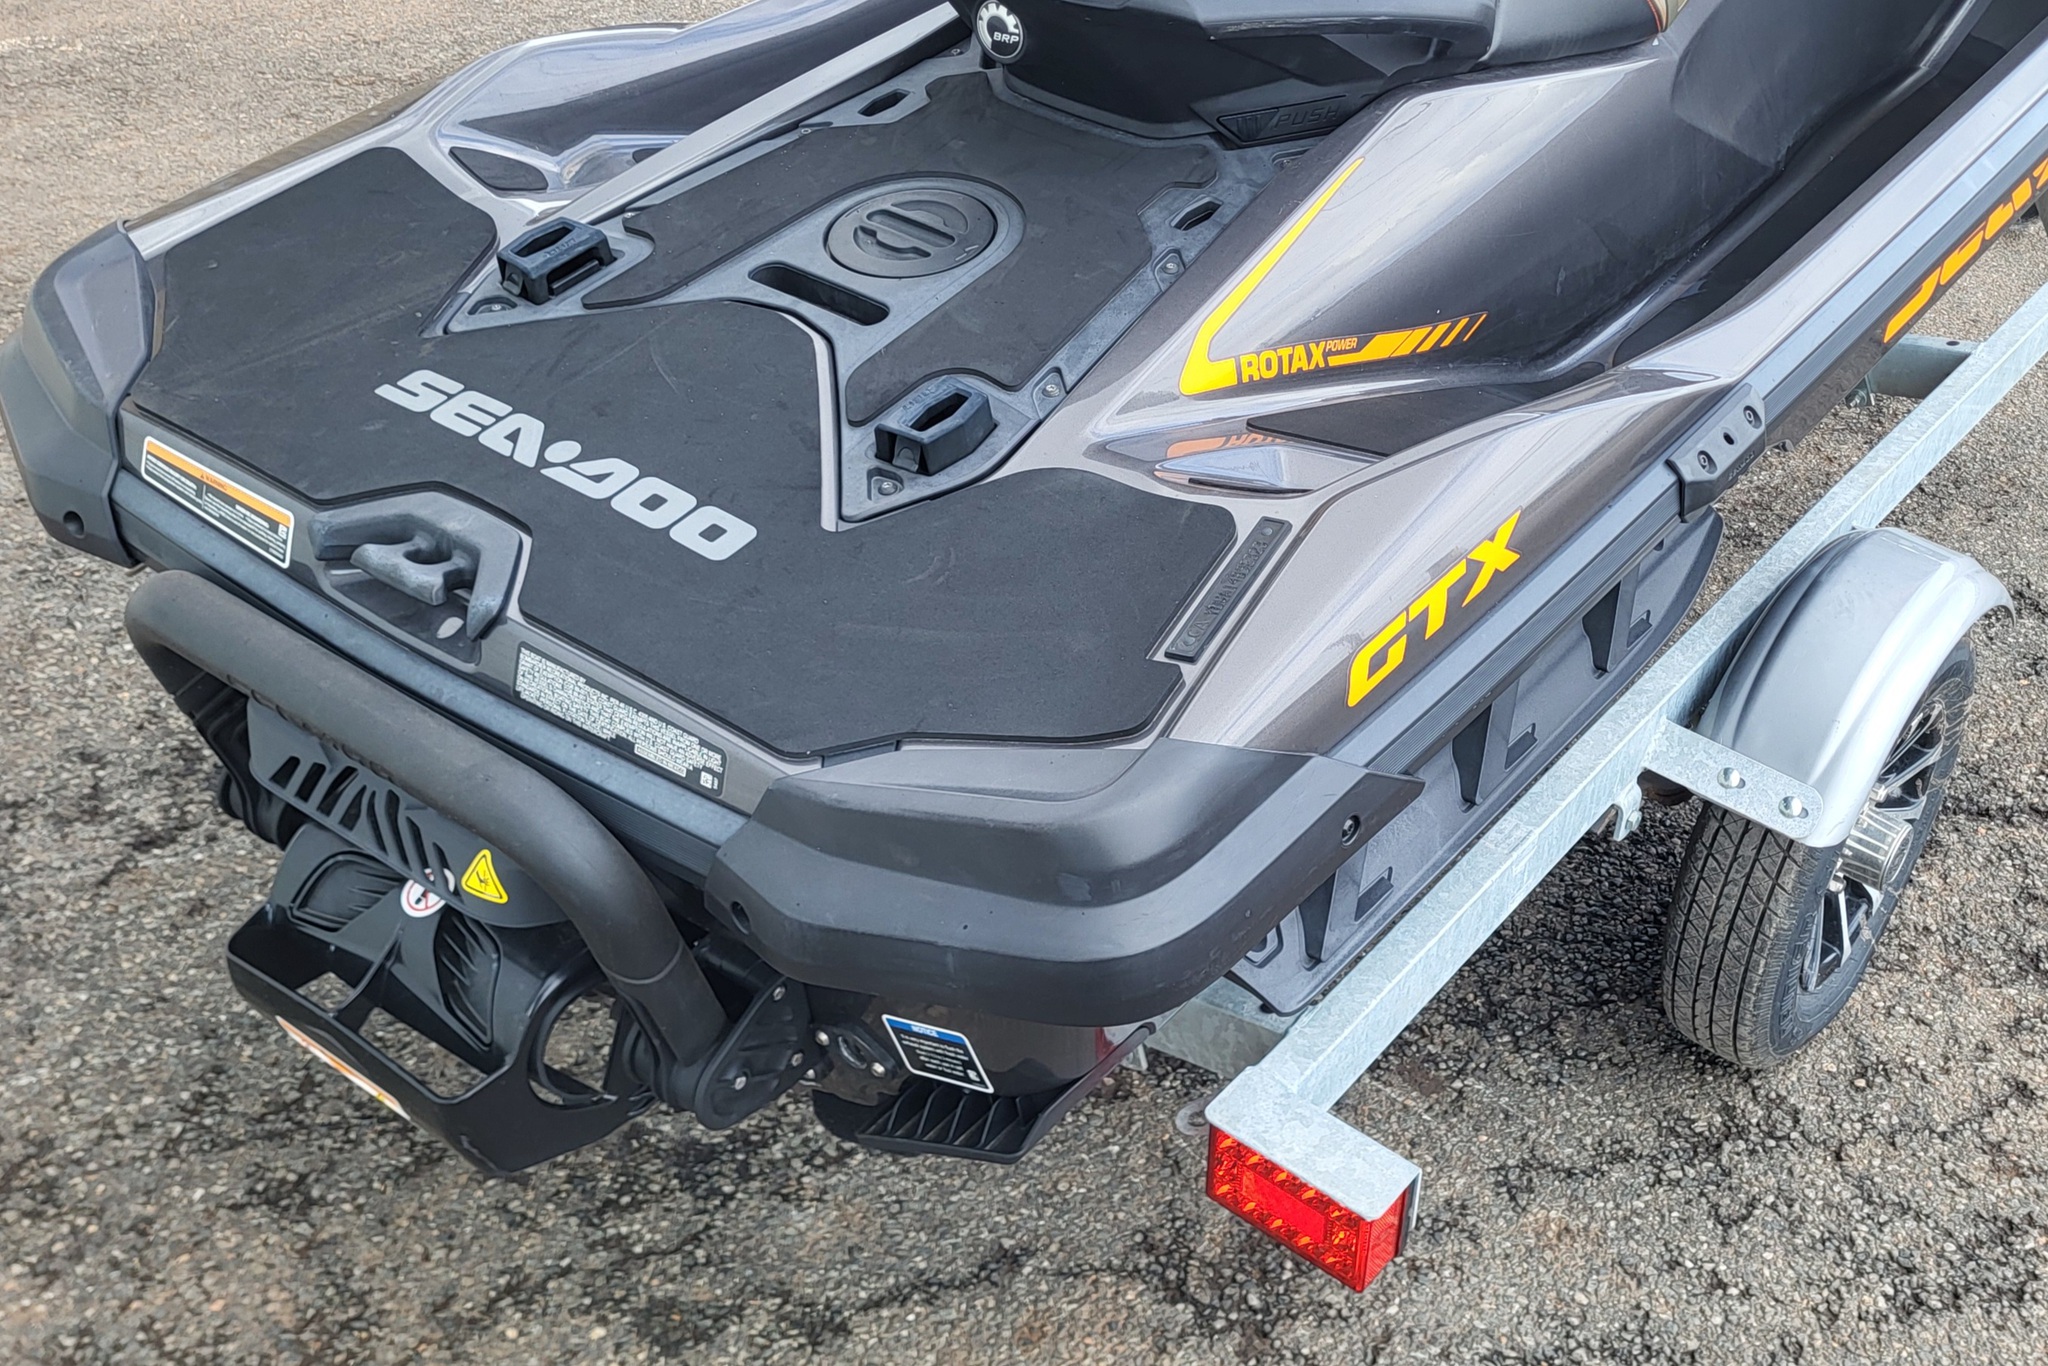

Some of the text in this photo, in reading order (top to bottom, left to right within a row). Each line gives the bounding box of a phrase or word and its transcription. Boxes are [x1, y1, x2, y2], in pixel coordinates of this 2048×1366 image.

[993, 31, 1019, 44] BRP
[1271, 105, 1340, 130] PUSH
[1240, 337, 1358, 383] ROTAX POWER
[1347, 508, 1522, 708] GTX
